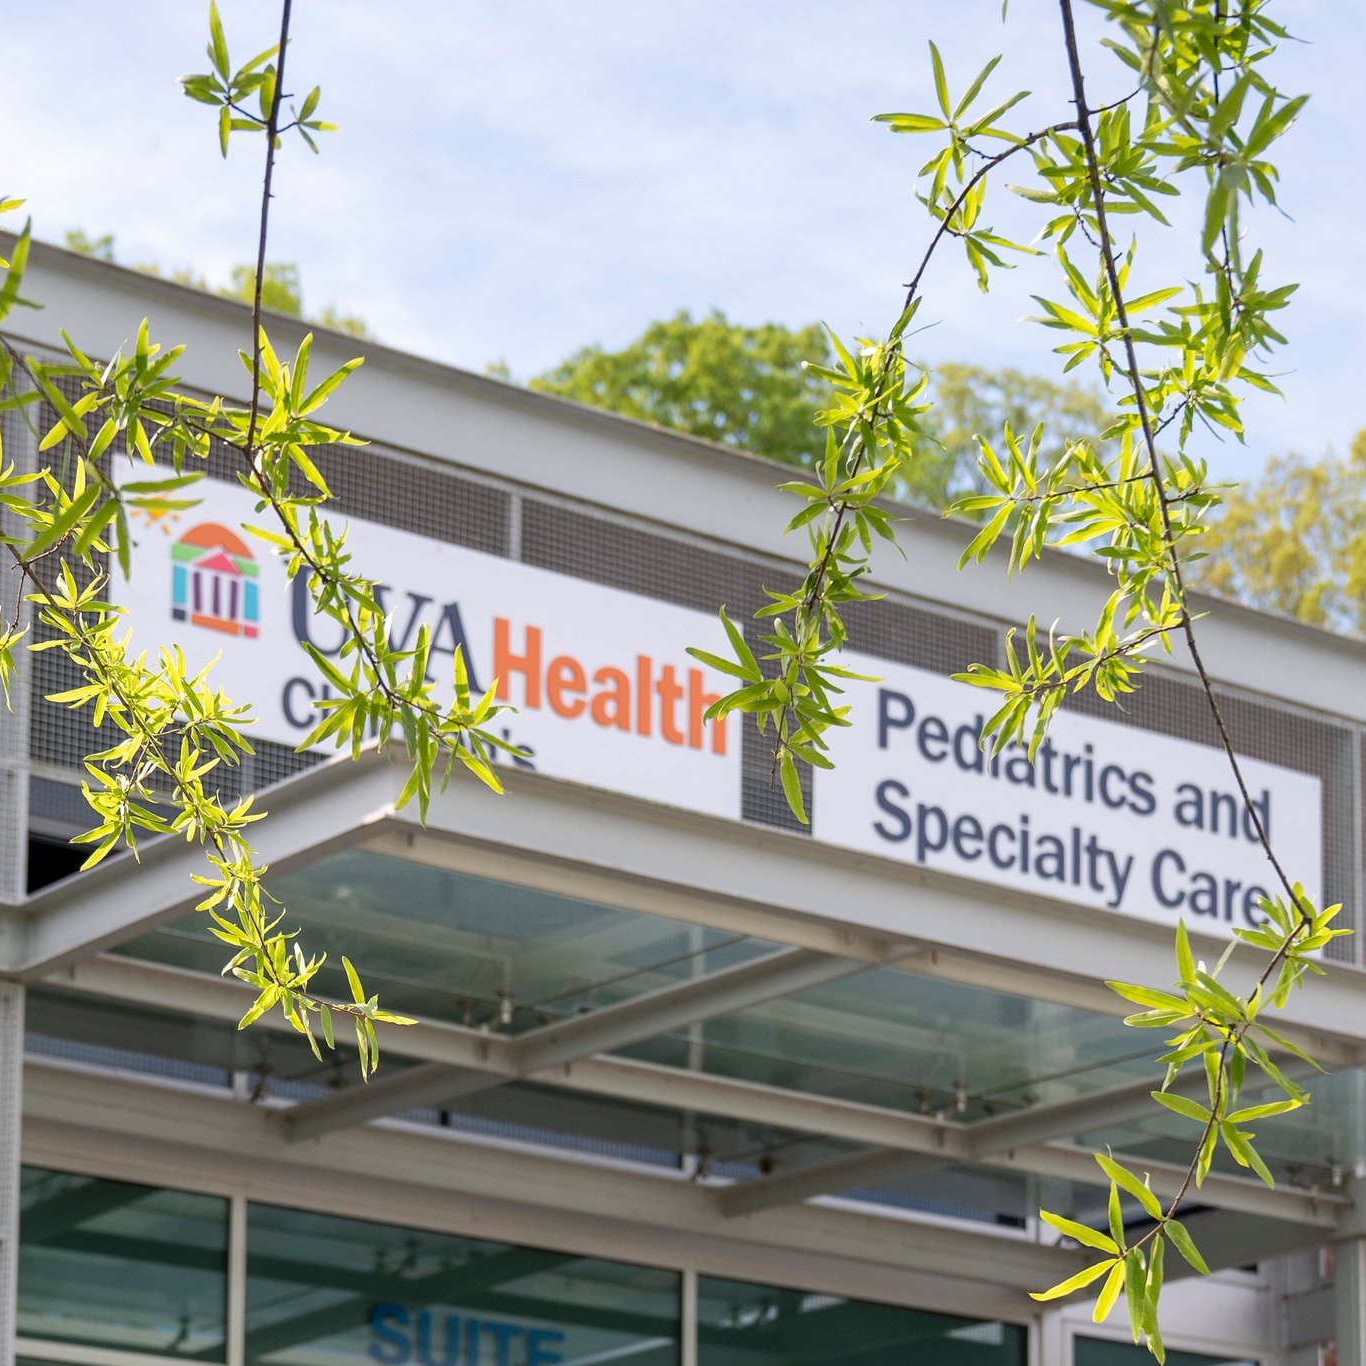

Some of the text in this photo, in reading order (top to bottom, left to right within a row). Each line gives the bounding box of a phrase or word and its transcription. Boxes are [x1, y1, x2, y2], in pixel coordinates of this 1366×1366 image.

[492, 614, 728, 757] Health
[877, 687, 1271, 843] Pediatrics and
[873, 779, 1272, 929] Specialty Care
